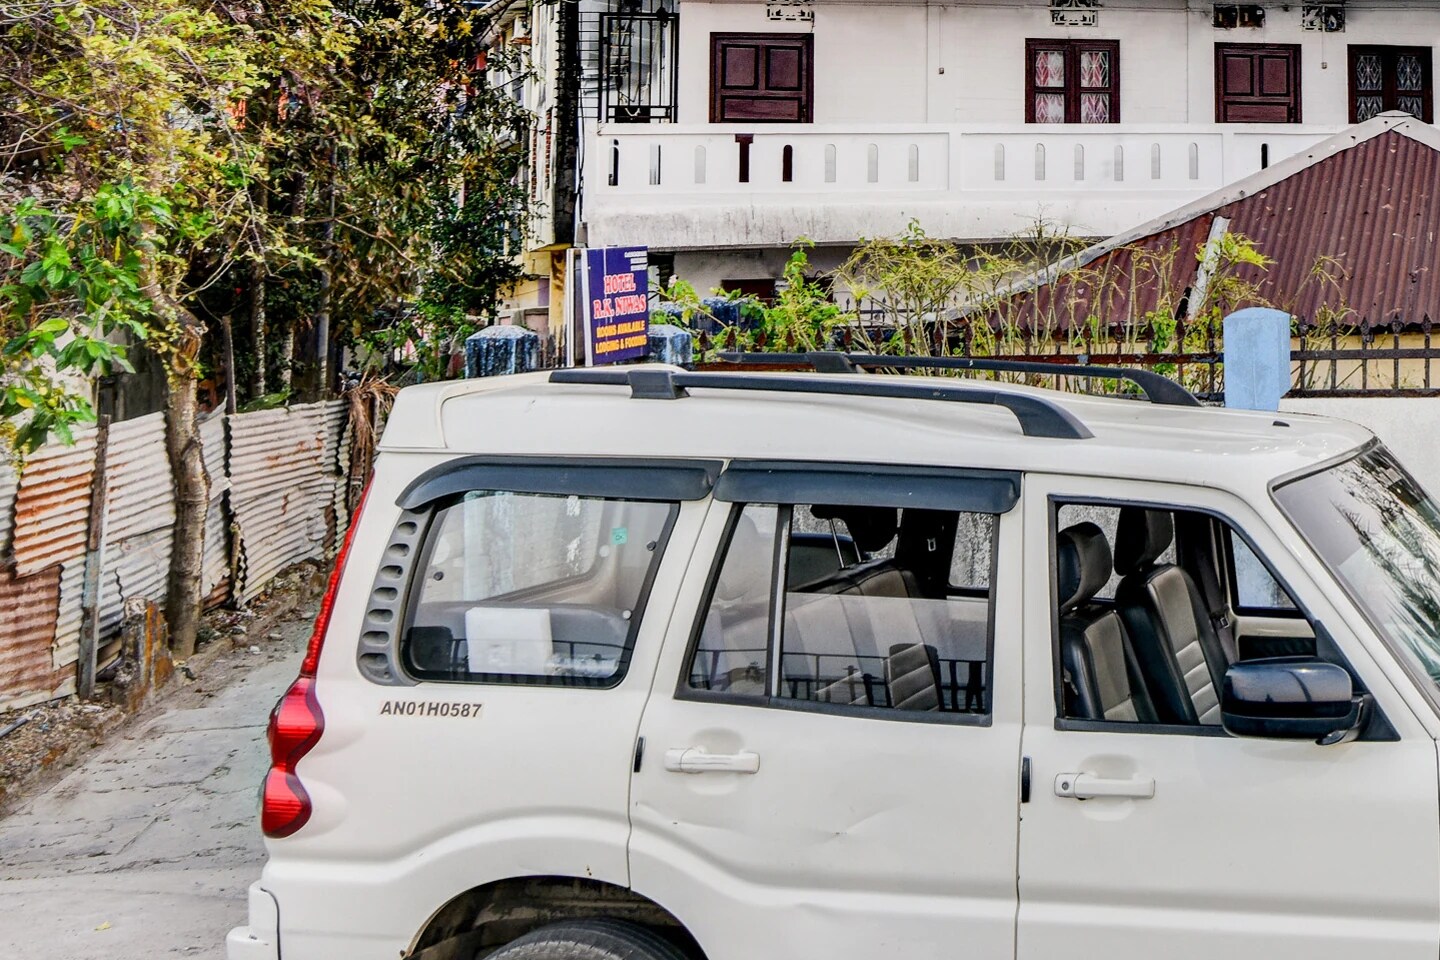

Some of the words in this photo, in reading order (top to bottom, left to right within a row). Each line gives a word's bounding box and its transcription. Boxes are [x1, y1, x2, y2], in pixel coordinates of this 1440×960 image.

[604, 273, 636, 294] HOTEL
[594, 299, 614, 319] R.K.
[615, 294, 646, 316] NIWAS
[380, 701, 482, 718] AN01H0587
